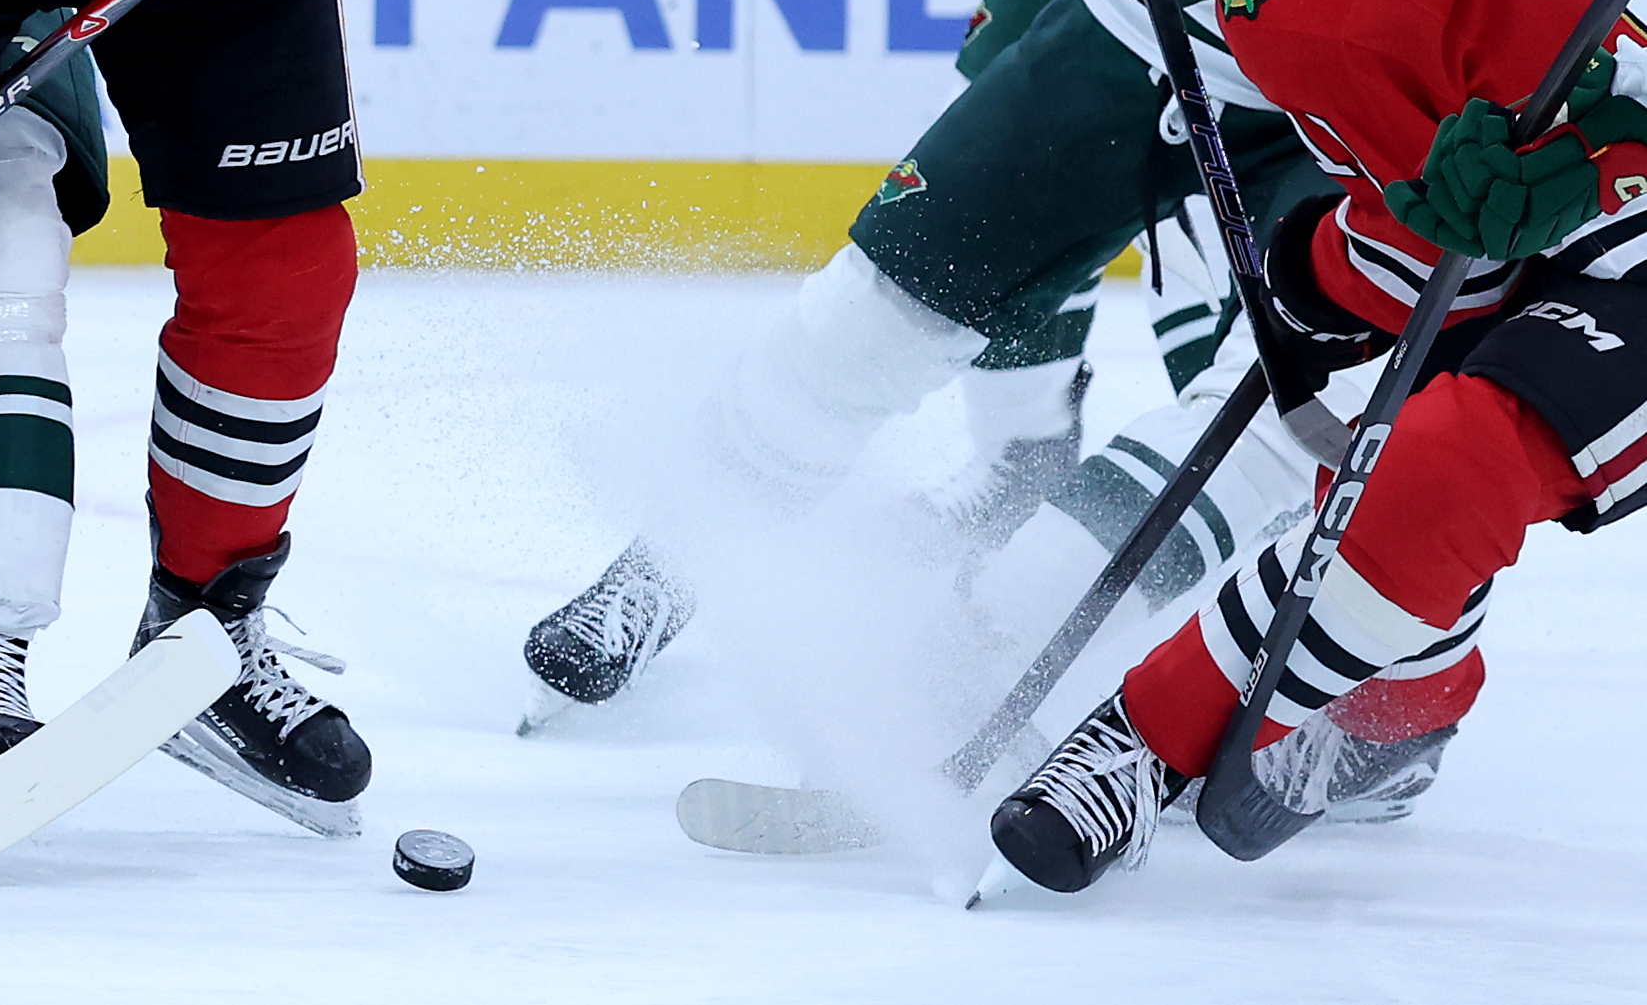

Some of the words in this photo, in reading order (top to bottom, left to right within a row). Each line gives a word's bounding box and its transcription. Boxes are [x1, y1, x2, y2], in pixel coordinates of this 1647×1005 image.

[217, 120, 353, 168] BAUER
[1293, 423, 1393, 599] CCM
[1240, 650, 1266, 705] CCM
